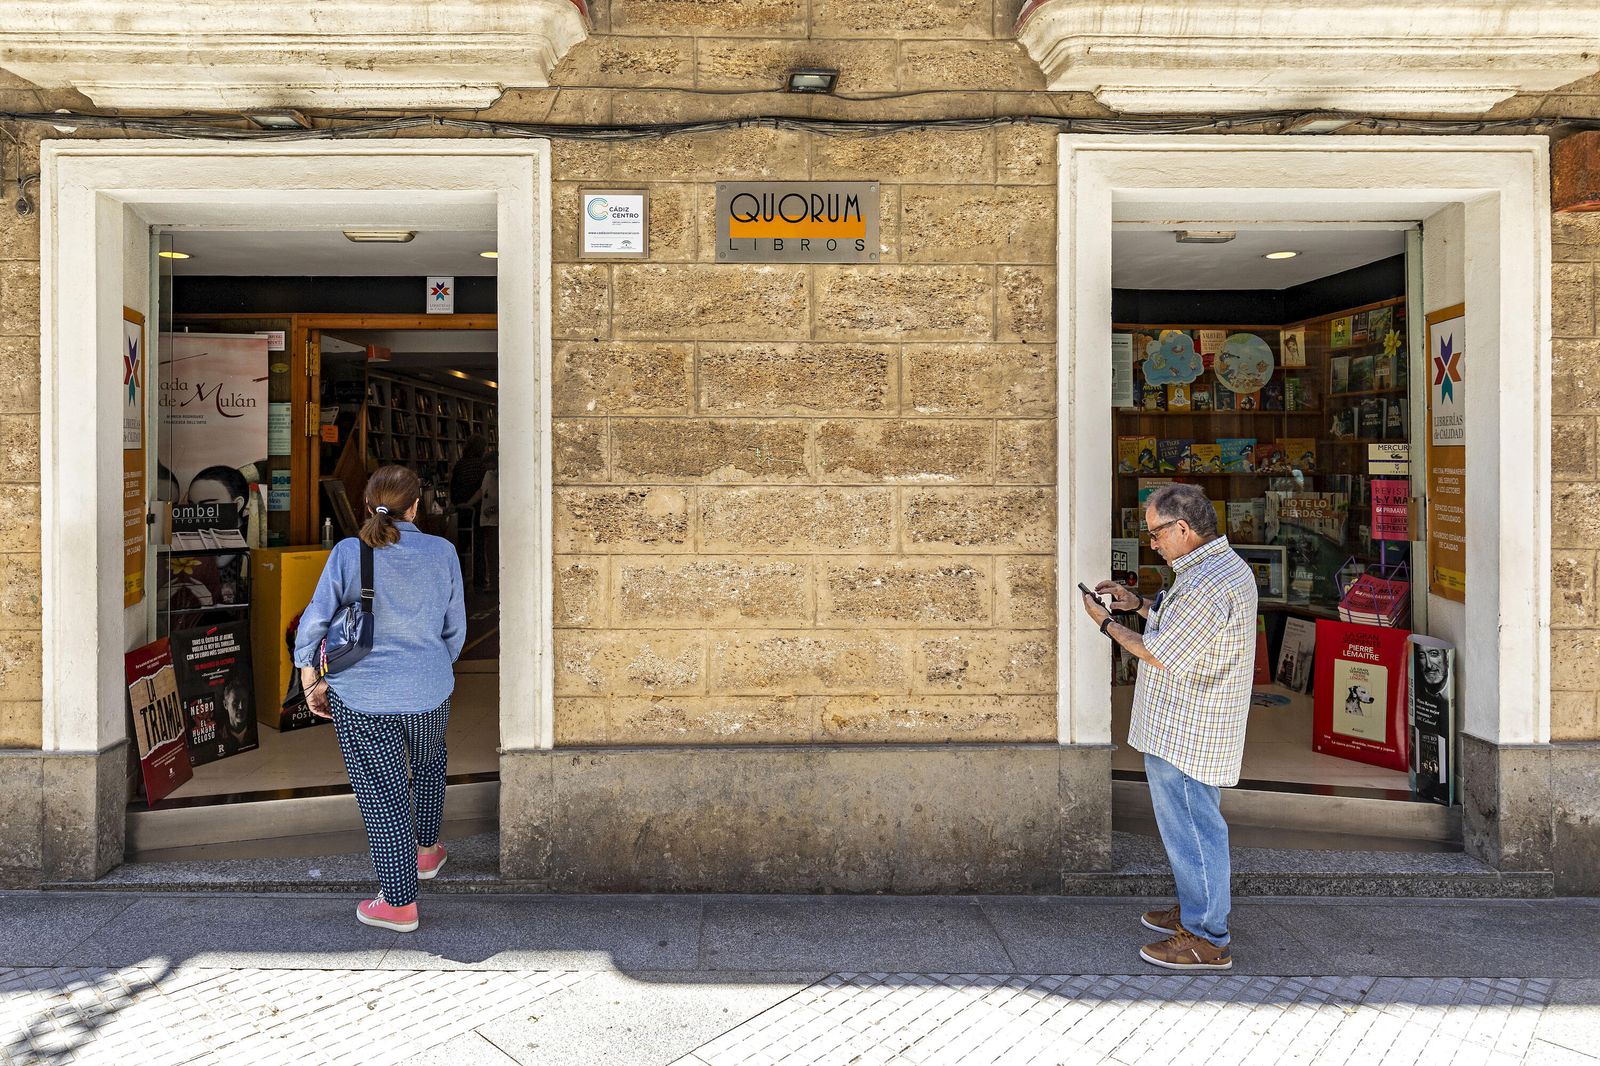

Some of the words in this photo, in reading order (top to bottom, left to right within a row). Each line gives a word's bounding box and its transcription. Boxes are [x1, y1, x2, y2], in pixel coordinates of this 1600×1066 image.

[730, 192, 861, 224] QUORUM
[729, 238, 865, 251] LIBROS
[158, 378, 189, 391] ada
[180, 381, 257, 418] Mulán
[1433, 412, 1464, 427] LIBRERÍAS
[1440, 428, 1464, 440] CALIDAD
[1375, 487, 1408, 496] REVIST
[1299, 499, 1312, 508] TE
[1313, 499, 1327, 508] LO
[1393, 496, 1408, 505] MA
[172, 504, 220, 518] ombel
[1348, 643, 1374, 654] PIERRE
[186, 653, 194, 661] CON
[1342, 649, 1380, 661] LEMAITRE
[145, 679, 157, 703] LA
[292, 710, 317, 720] POST
[140, 691, 183, 752] TRAMA
